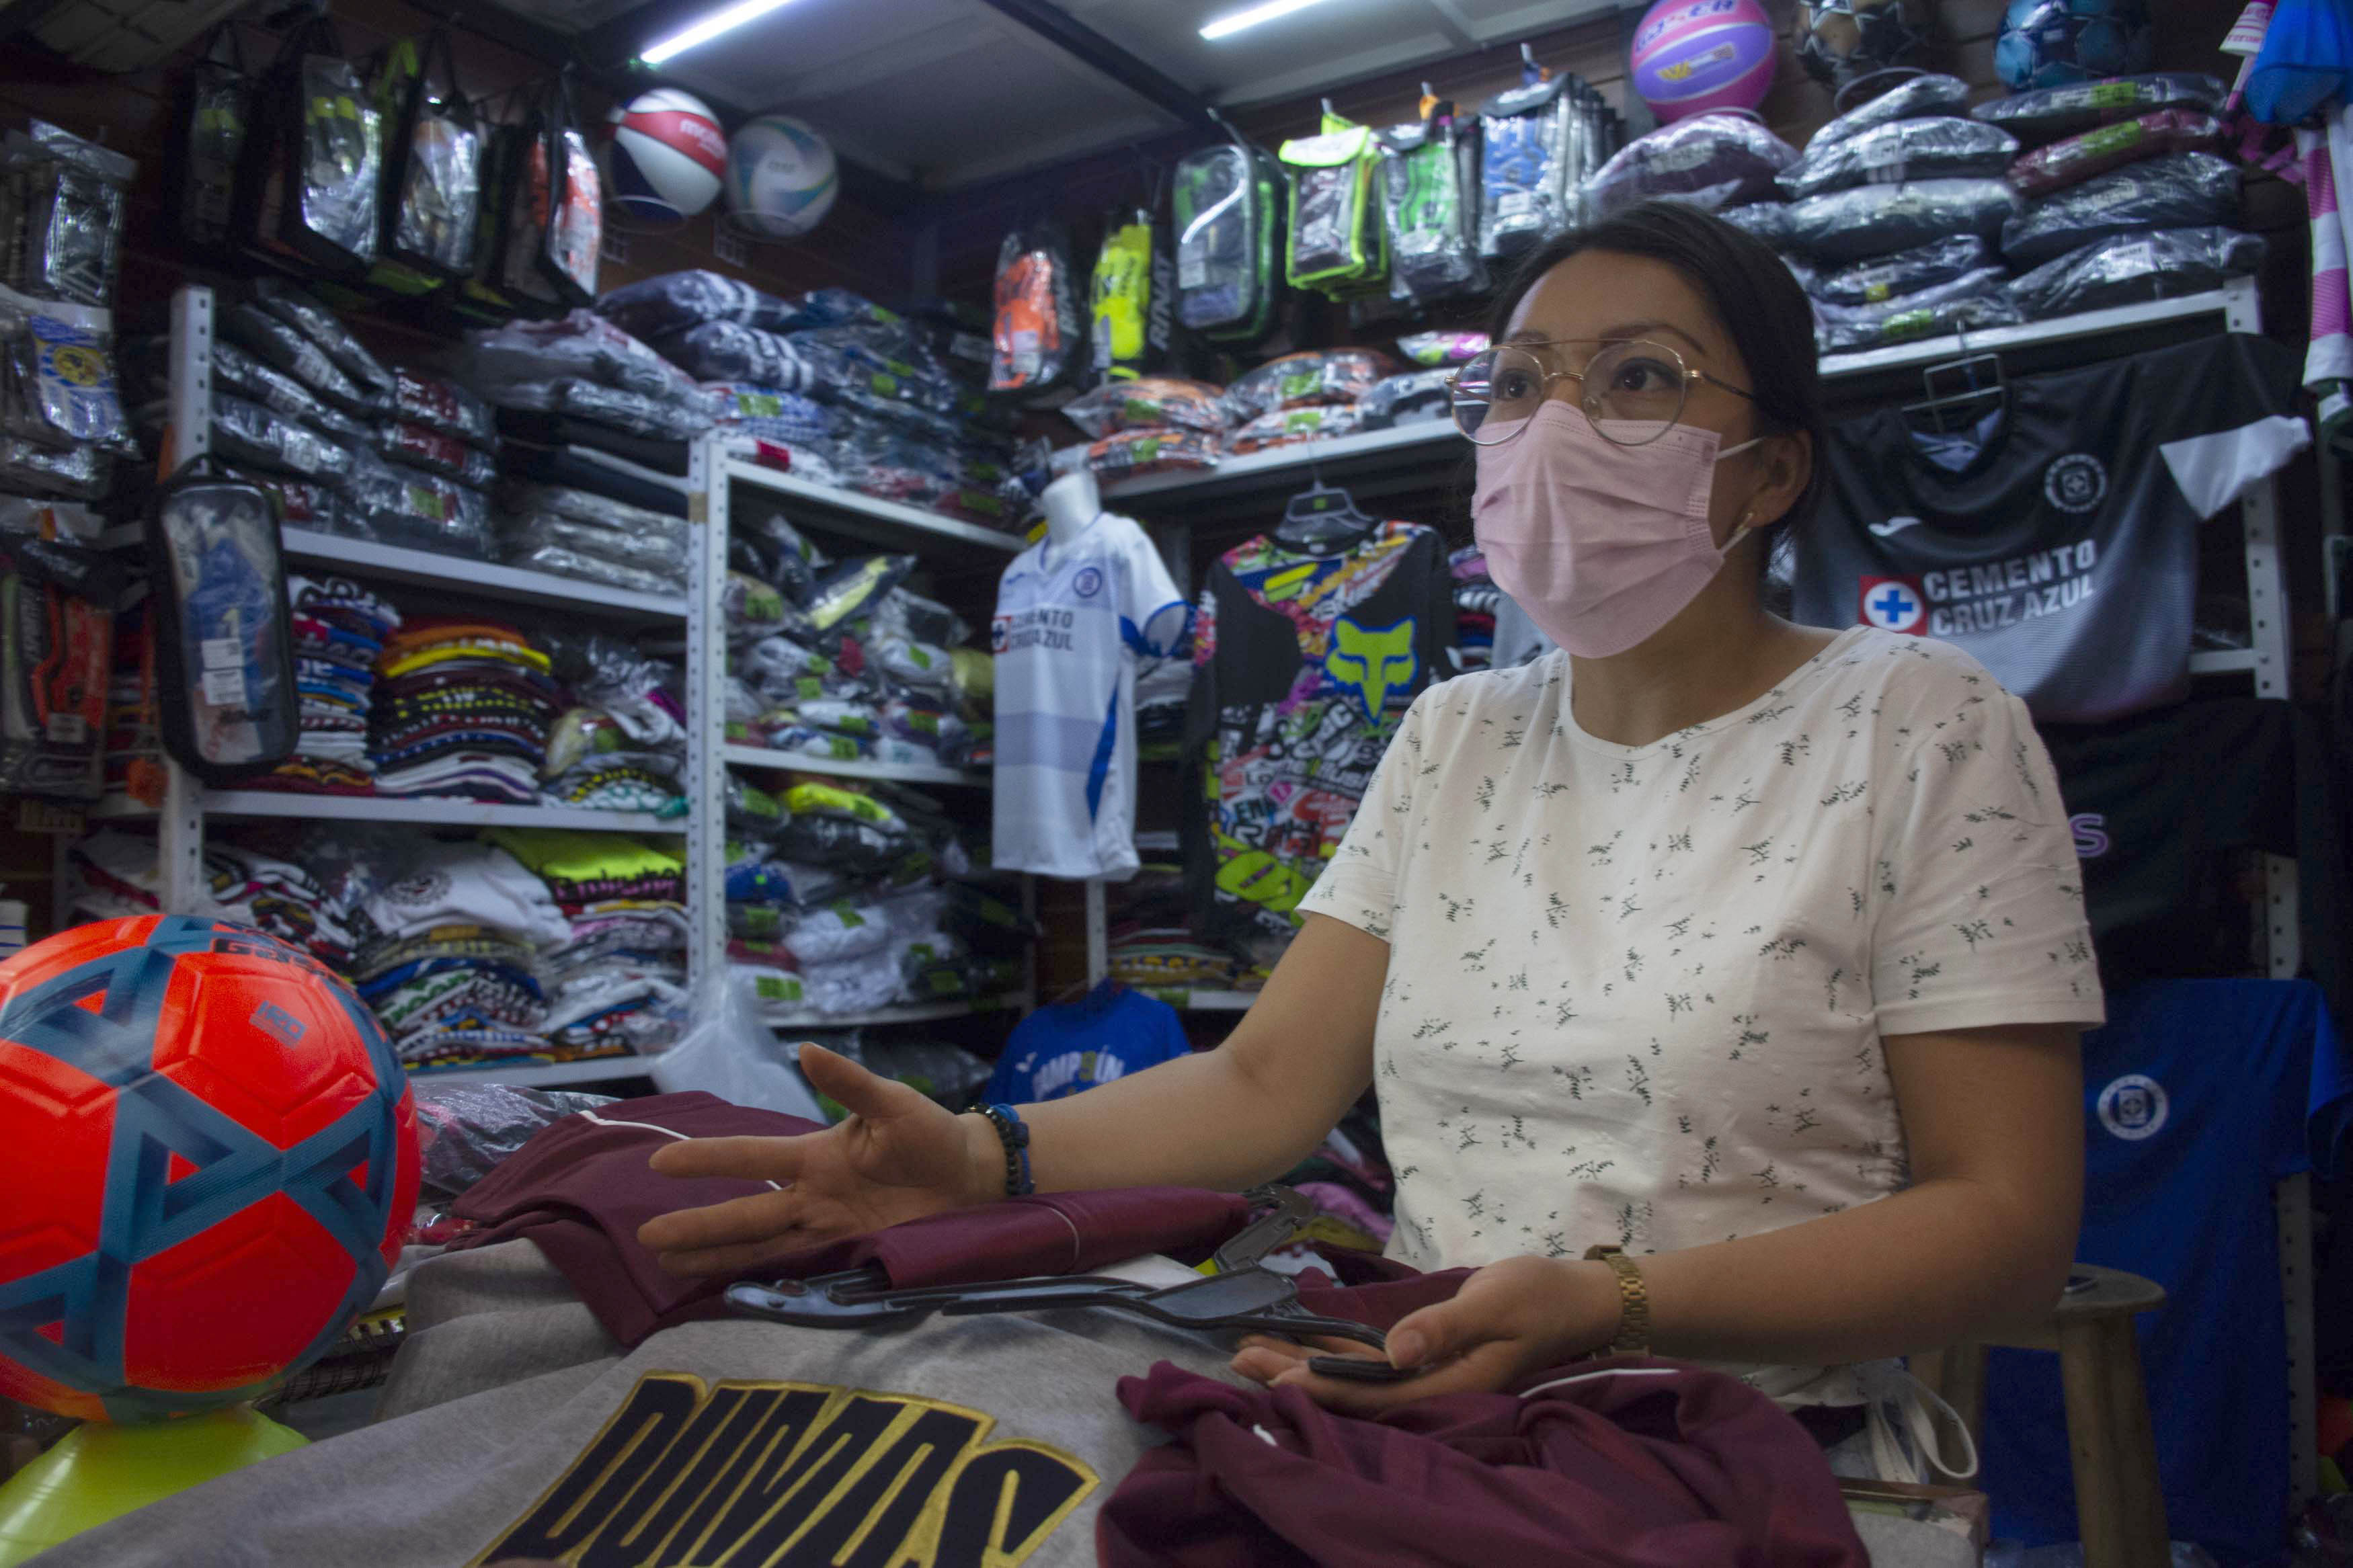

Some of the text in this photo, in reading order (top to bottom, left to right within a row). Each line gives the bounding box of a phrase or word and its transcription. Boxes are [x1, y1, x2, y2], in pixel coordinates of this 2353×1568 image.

[1923, 538, 2096, 602] CEMENTO
[1931, 574, 2094, 636] CRUZ AZUL
